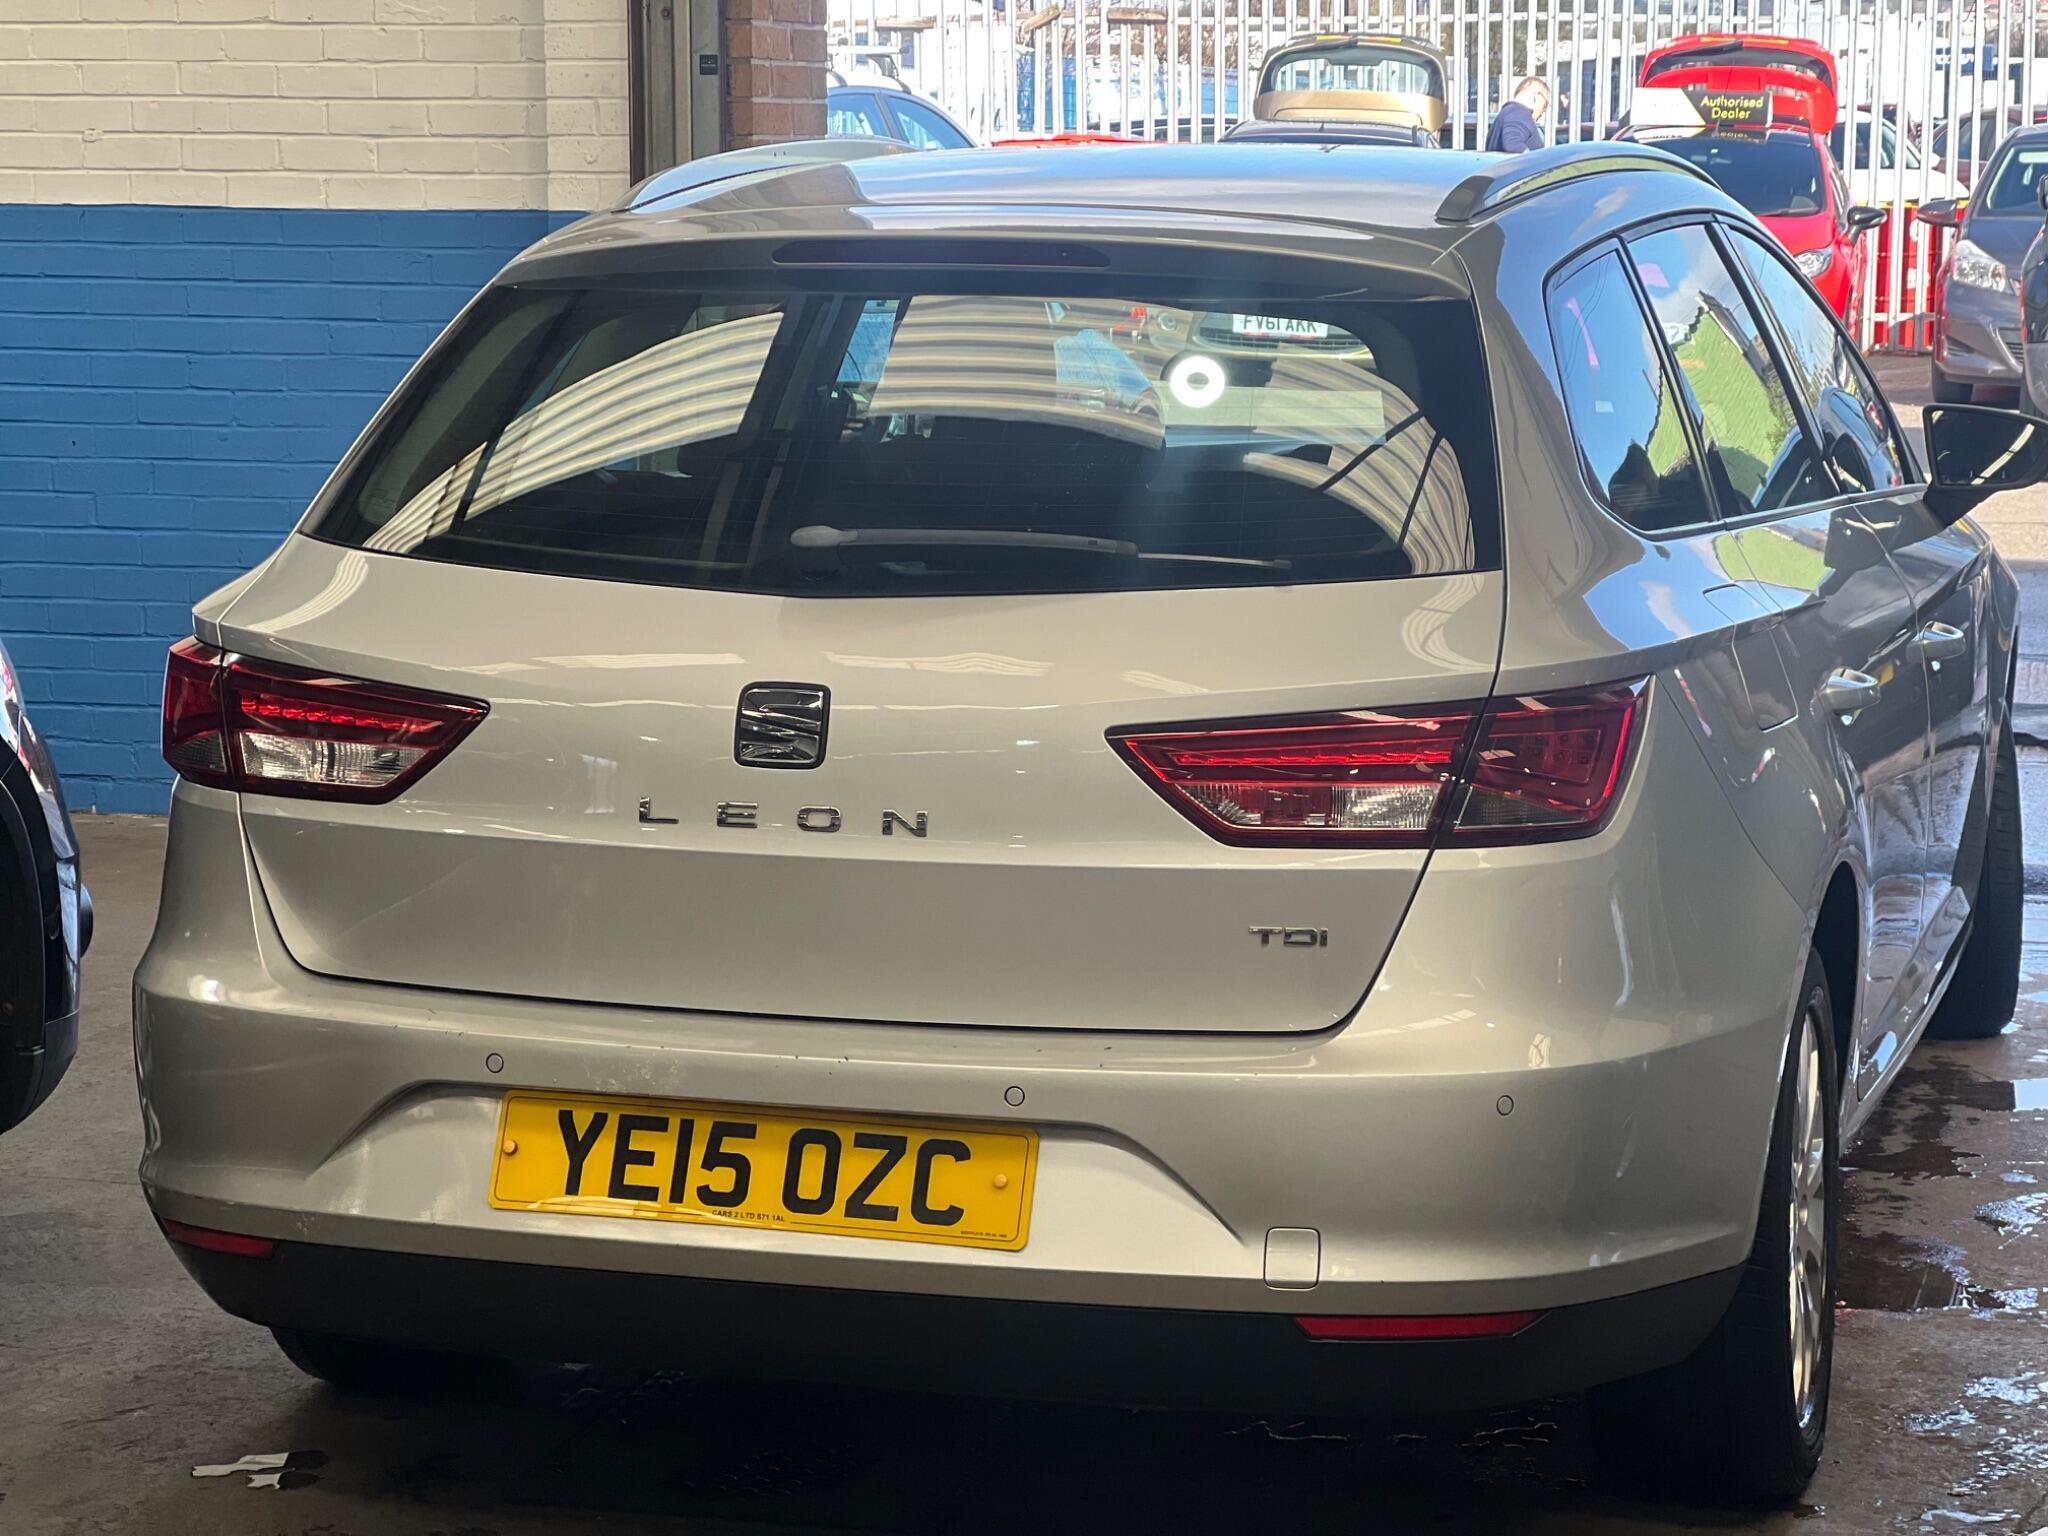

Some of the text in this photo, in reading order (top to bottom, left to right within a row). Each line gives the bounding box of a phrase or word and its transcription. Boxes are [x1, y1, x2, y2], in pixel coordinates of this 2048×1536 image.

[1700, 95, 1764, 107] Authorised
[1711, 107, 1751, 119] Dealer
[1243, 315, 1280, 331] FV61
[638, 796, 928, 838] LEON
[557, 1109, 972, 1227] YE15 OZC
[711, 1209, 733, 1218] CARS
